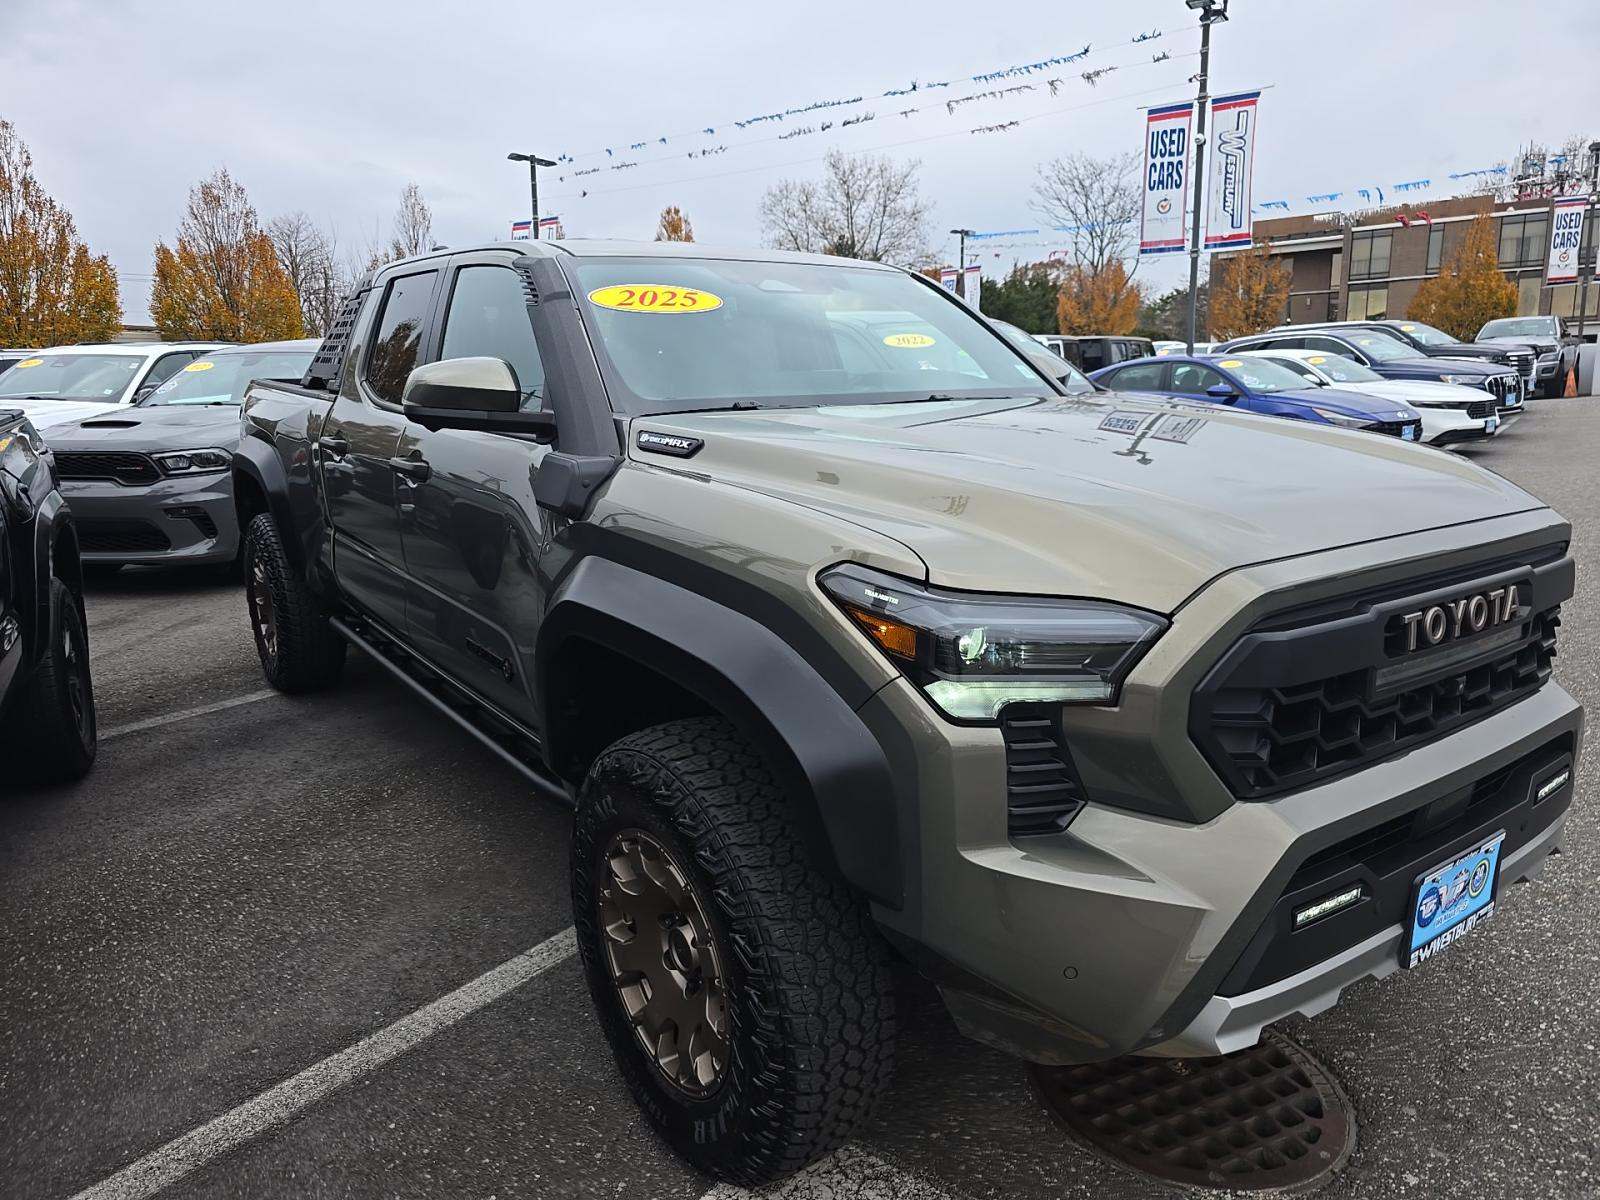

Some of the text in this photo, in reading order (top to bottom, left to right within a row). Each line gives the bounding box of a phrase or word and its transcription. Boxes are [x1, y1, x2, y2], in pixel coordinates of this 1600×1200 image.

[1150, 127, 1186, 159] USED
[1148, 160, 1184, 192] CARS
[1218, 110, 1248, 228] WESTBURY
[1555, 212, 1582, 230] USED
[1553, 231, 1580, 249] CARS
[615, 289, 699, 307] 2025
[1402, 585, 1520, 651] TOYOTA
[1419, 914, 1482, 962] WESTBURY
